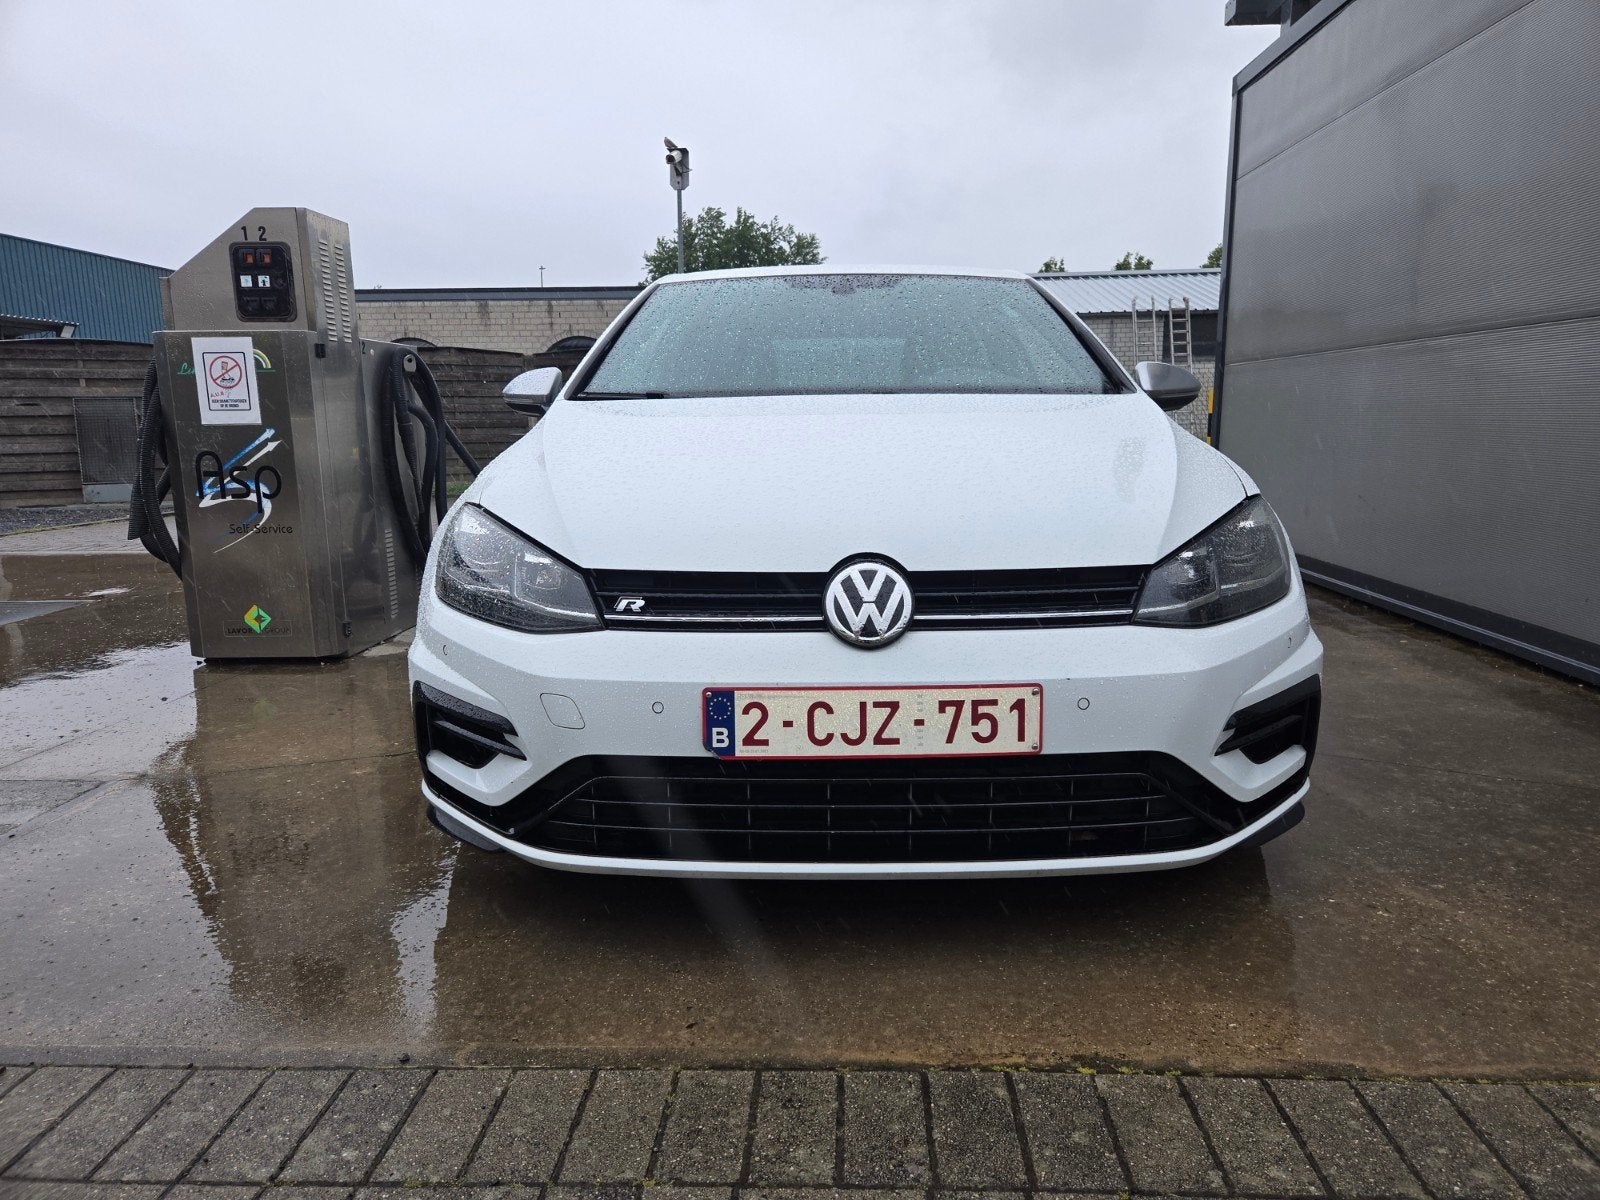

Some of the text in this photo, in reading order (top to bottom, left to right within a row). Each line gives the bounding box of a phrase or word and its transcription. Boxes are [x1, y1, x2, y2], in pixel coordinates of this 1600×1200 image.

[241, 225, 267, 241] 1 2
[195, 450, 282, 514] Asp
[613, 596, 646, 612] R
[741, 698, 1027, 747] 2-CJZ-751
[711, 727, 730, 748] B
